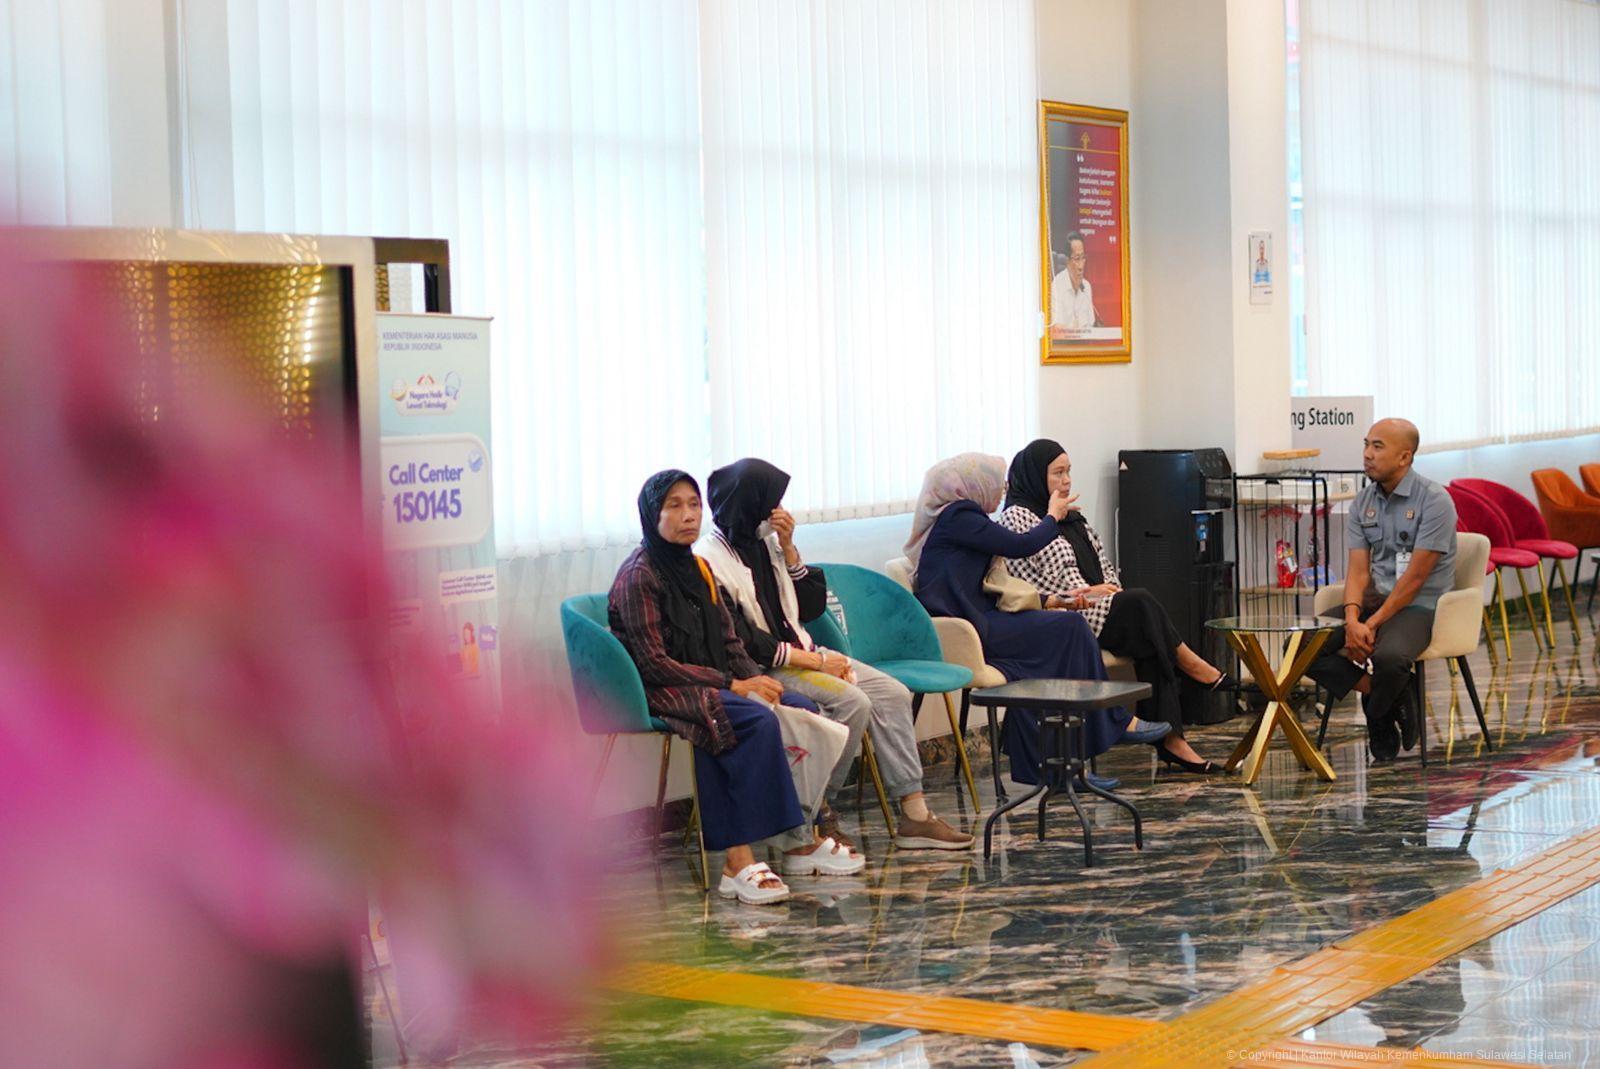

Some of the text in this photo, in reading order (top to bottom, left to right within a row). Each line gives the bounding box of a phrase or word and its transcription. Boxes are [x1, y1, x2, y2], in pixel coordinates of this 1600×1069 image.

[383, 342, 442, 351] REPUBLIK INDONESIA
[1308, 407, 1354, 426] Station
[389, 462, 464, 486] Call Center
[393, 488, 462, 524] 150145
